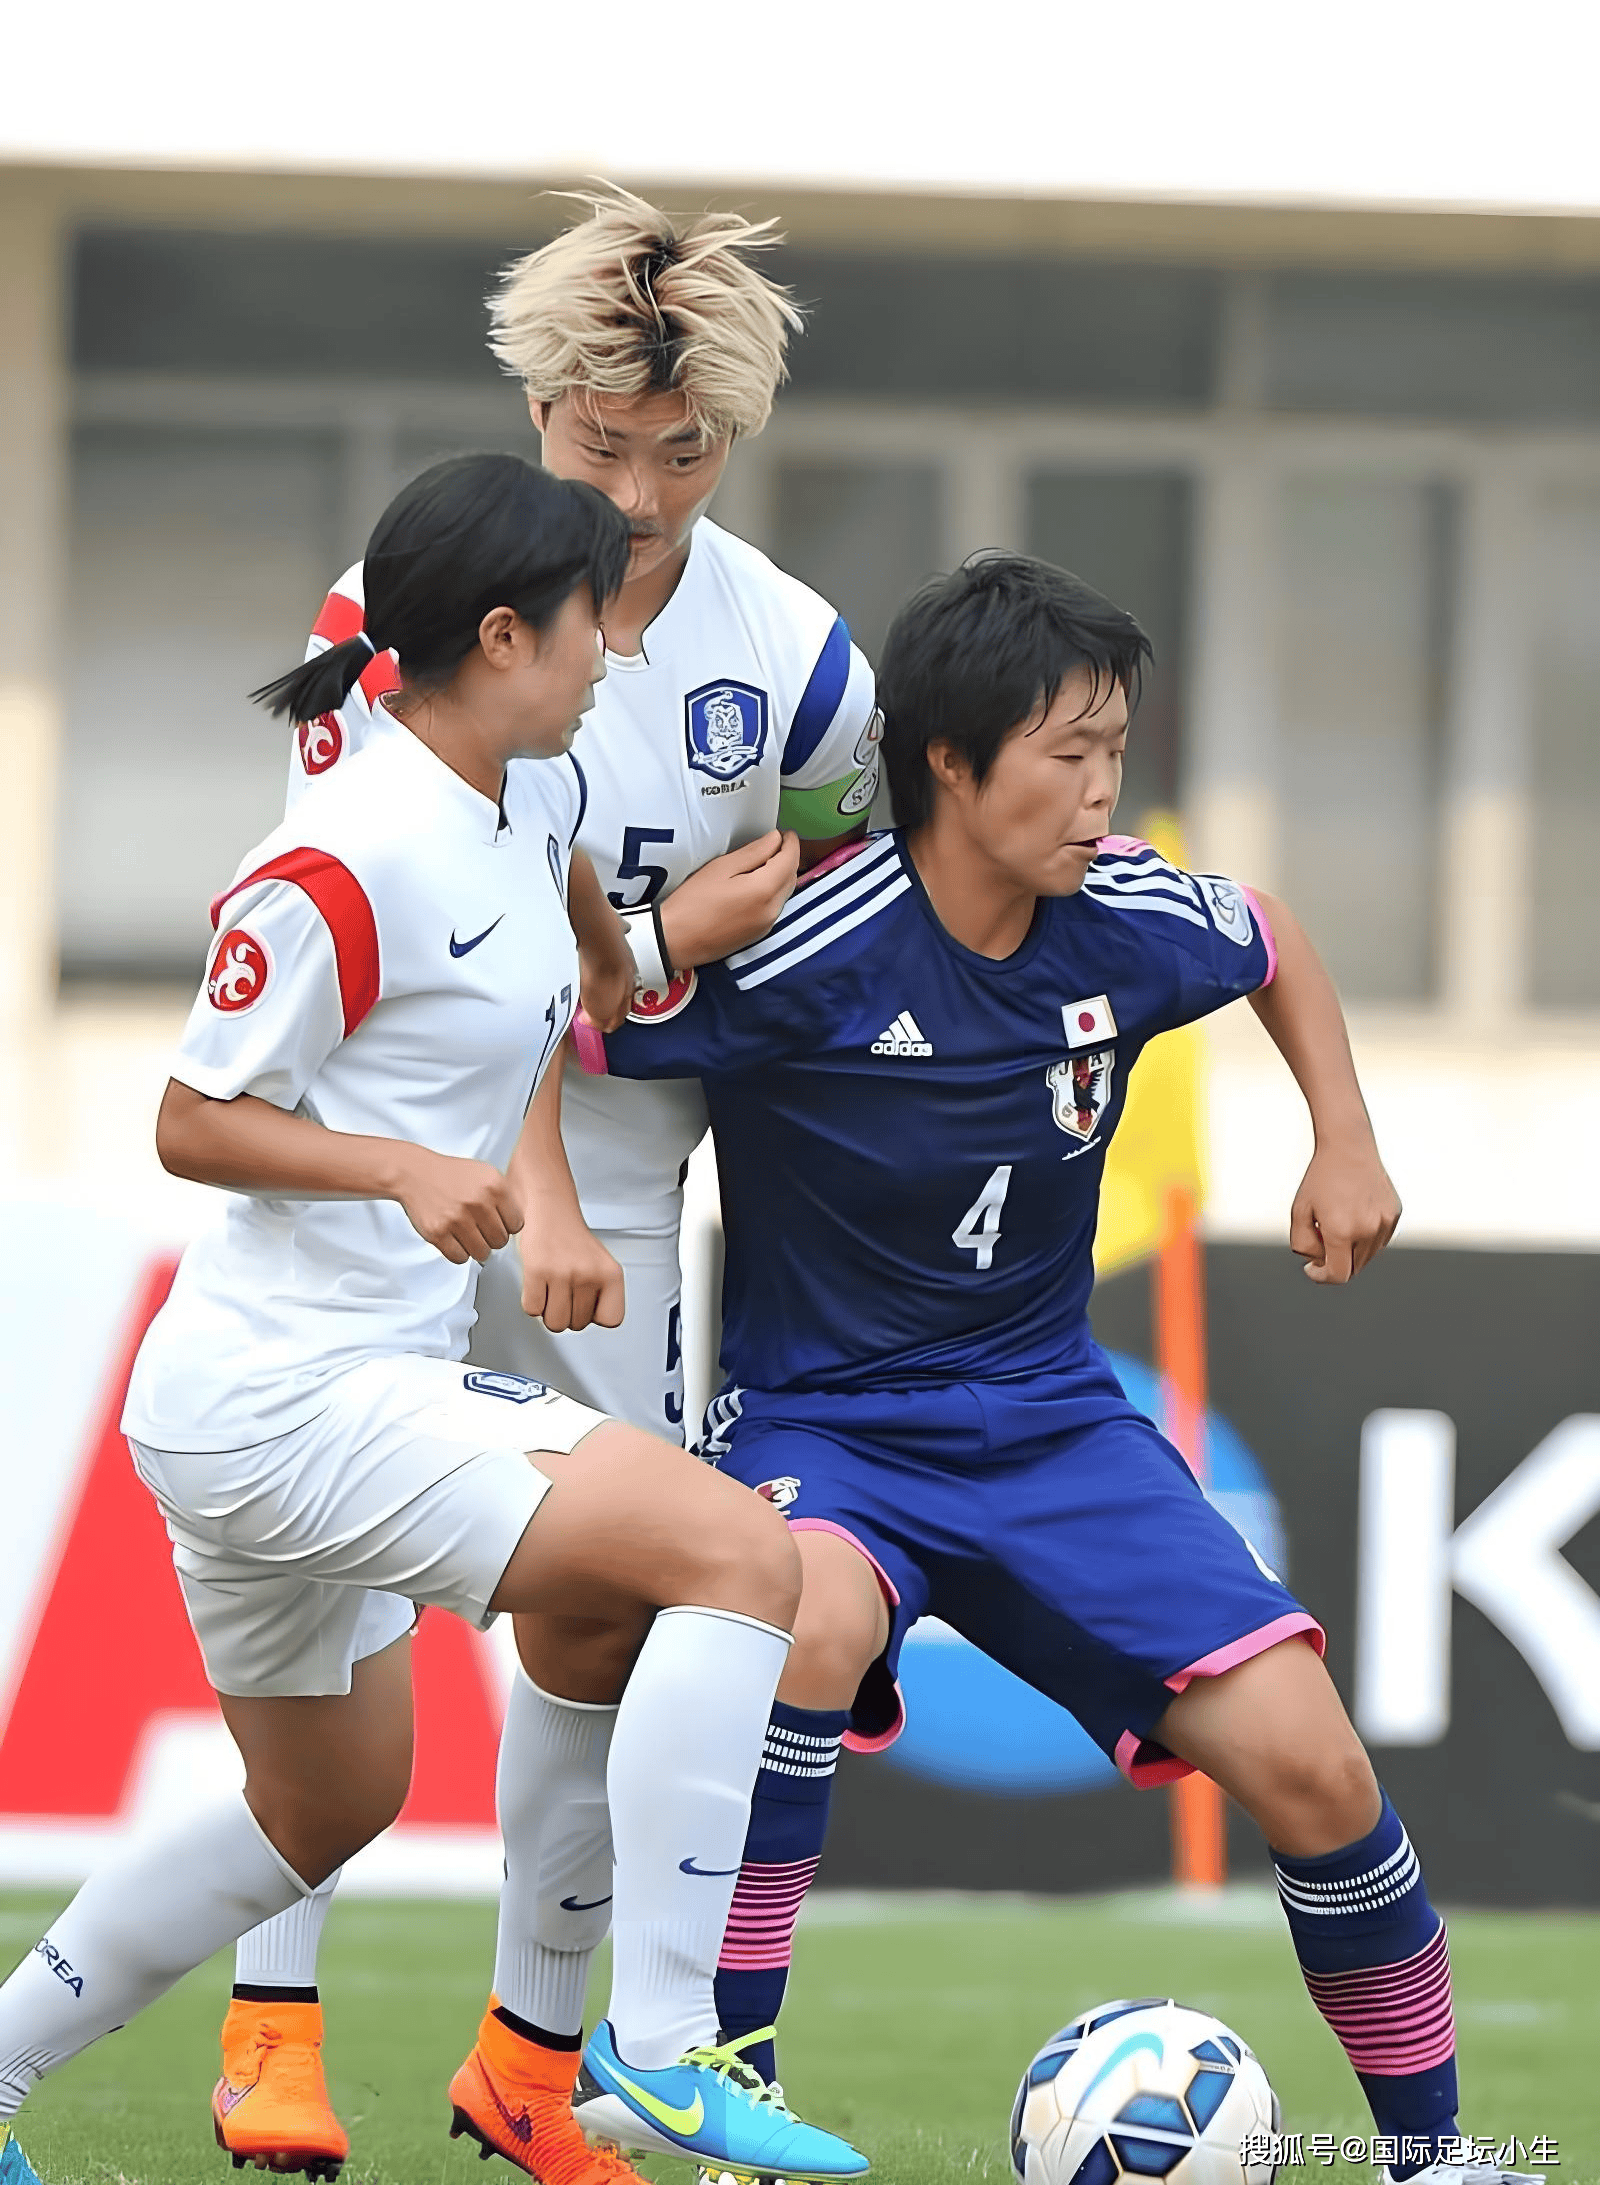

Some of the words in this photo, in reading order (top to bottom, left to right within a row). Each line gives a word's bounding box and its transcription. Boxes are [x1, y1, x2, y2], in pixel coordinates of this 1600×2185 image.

[607, 826, 674, 910] 5
[870, 1042, 933, 1057] adidas
[951, 1165, 1012, 1270] 4
